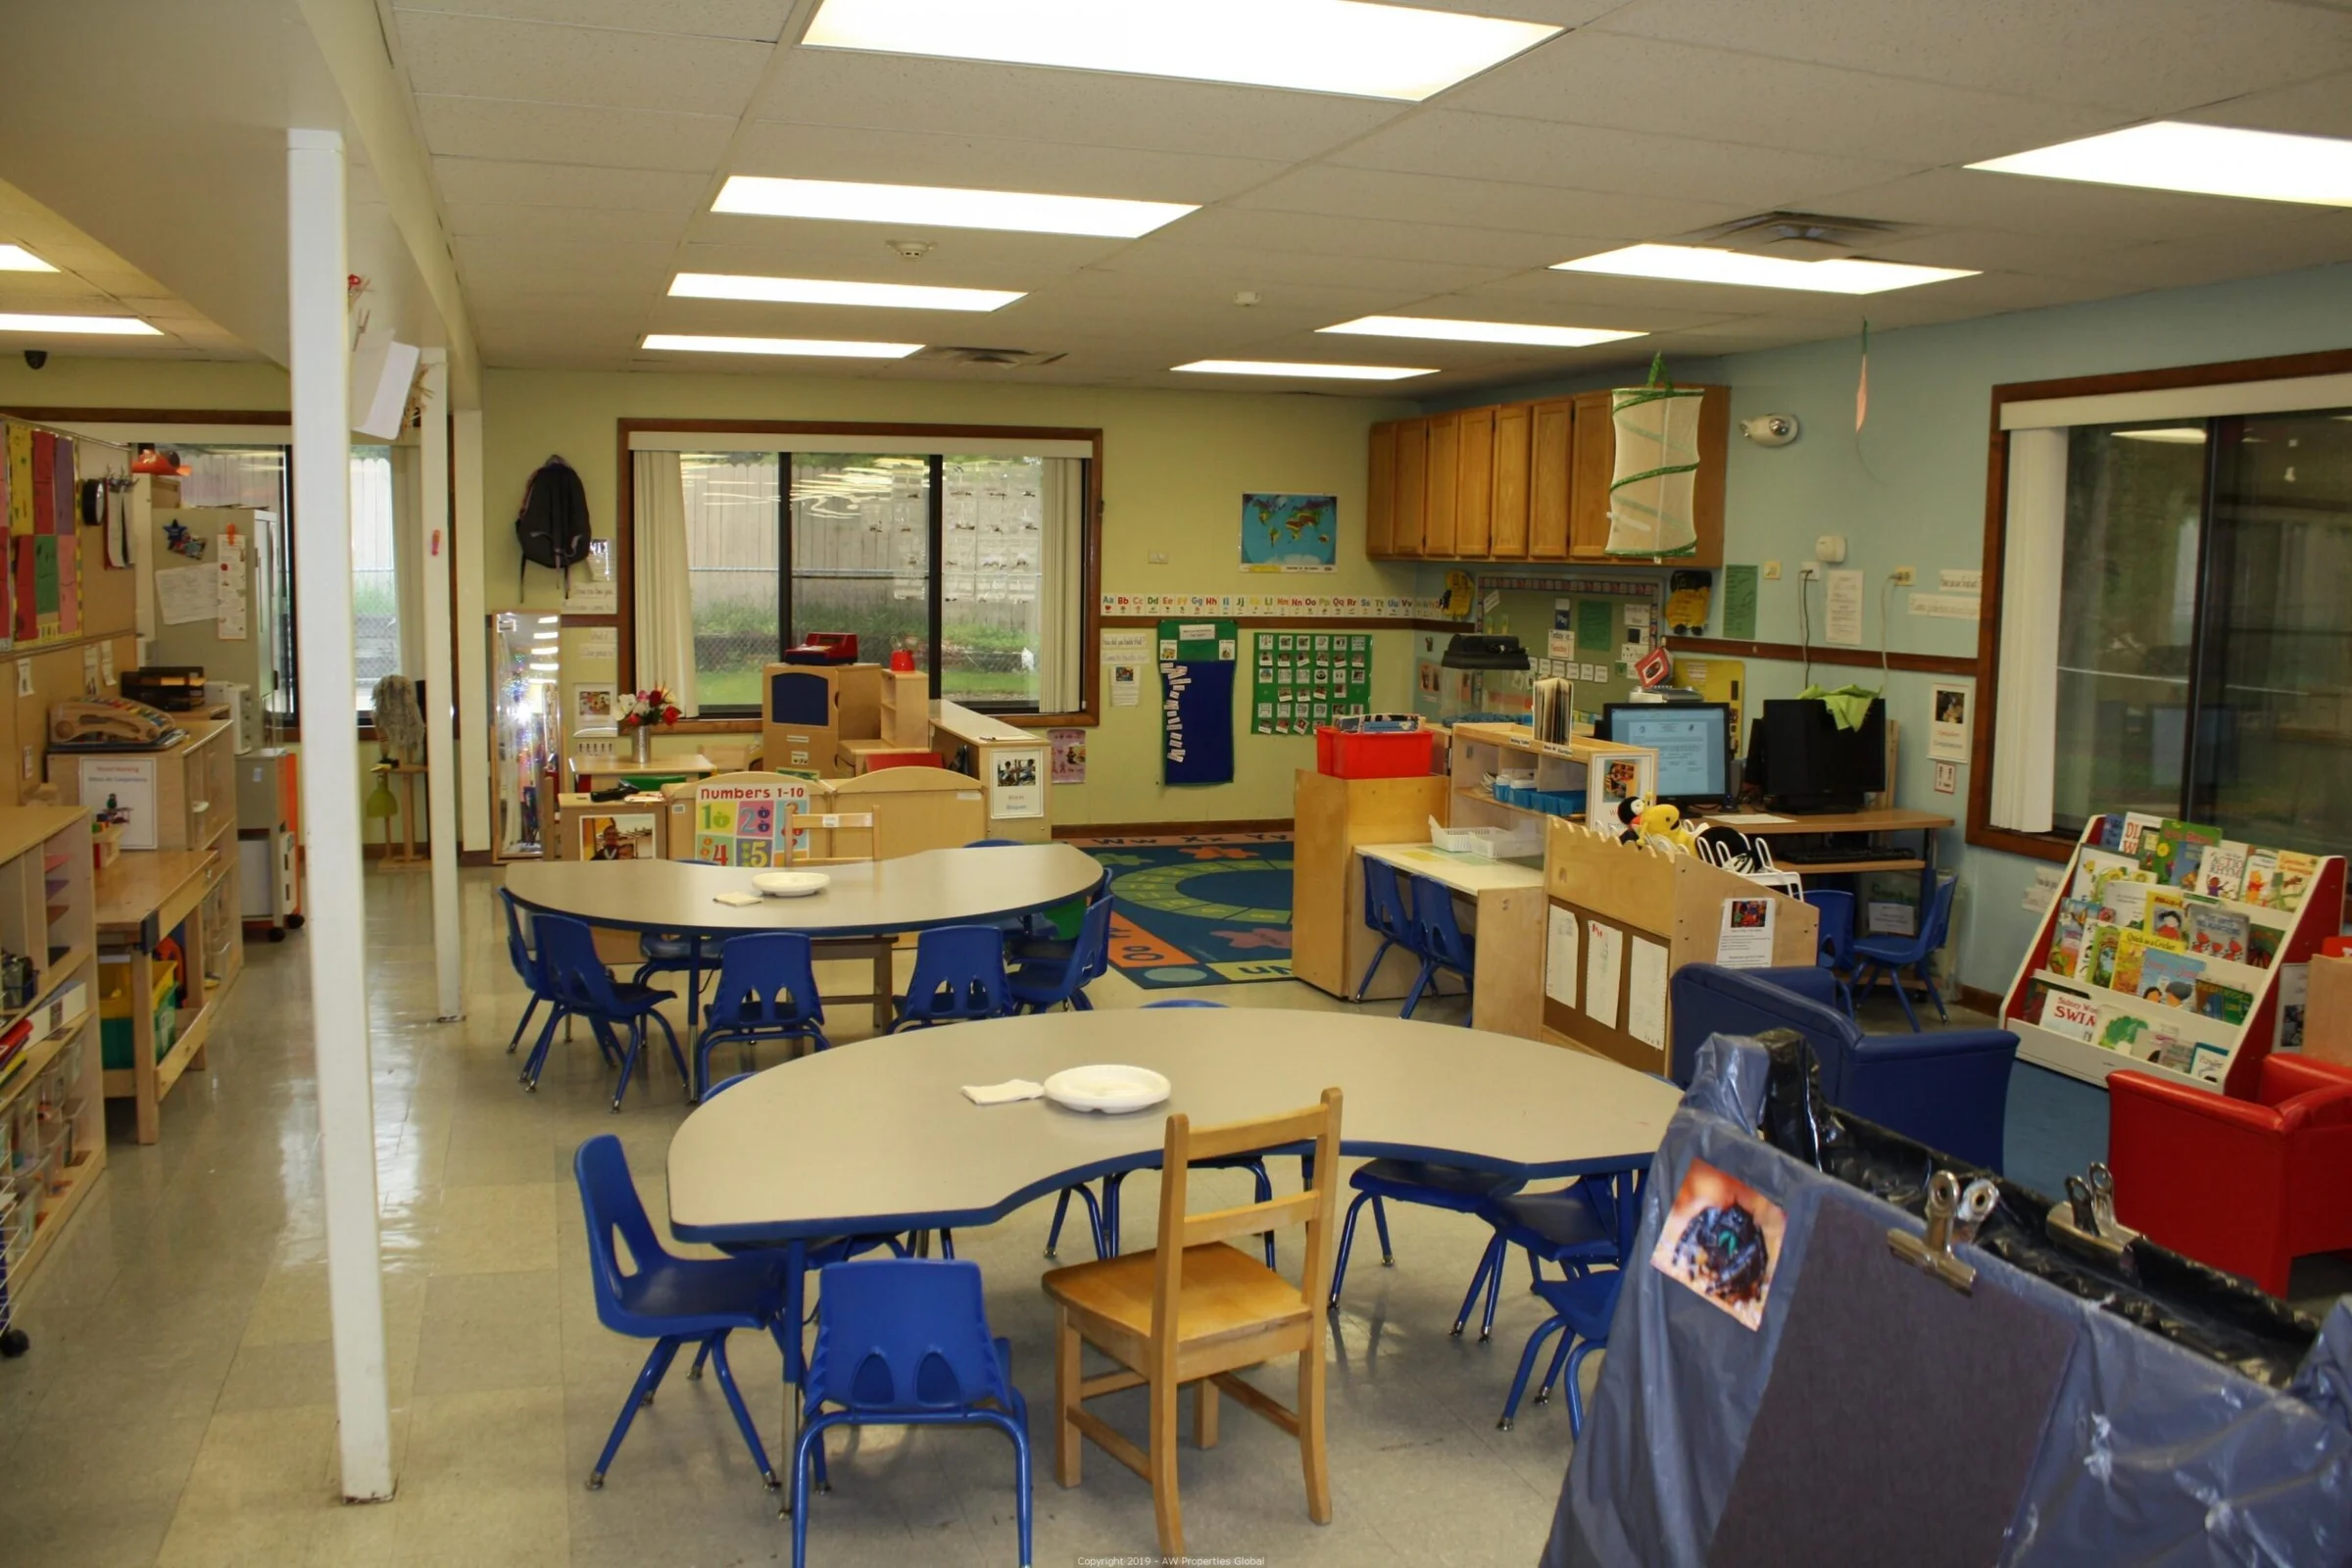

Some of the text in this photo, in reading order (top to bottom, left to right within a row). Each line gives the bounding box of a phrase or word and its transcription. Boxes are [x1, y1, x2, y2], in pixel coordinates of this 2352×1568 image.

[1205, 597, 1217, 606] Hh
[701, 787, 805, 800] Numbers 1-10
[702, 804, 711, 830] 1
[740, 807, 758, 833] 2
[712, 844, 729, 866] 4
[750, 840, 768, 867] 5
[2058, 996, 2082, 1008] Sidney
